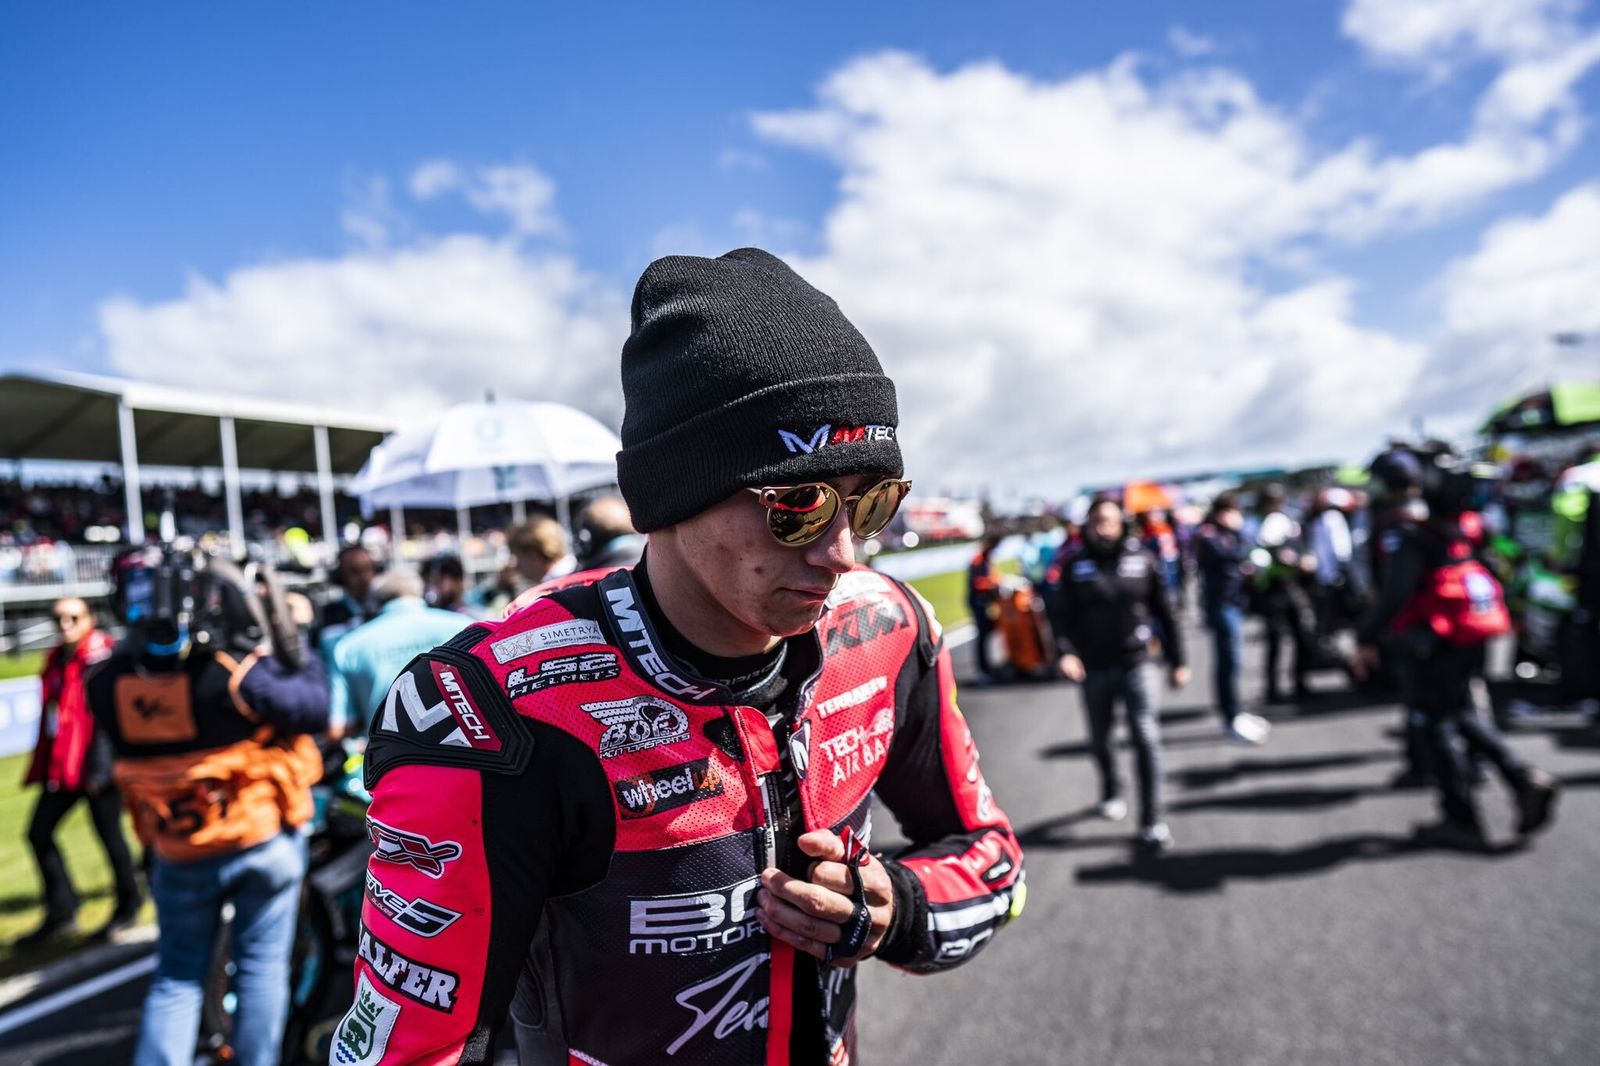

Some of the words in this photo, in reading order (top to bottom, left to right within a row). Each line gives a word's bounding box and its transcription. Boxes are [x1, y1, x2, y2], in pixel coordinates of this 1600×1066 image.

[507, 653, 617, 689] LS2
[605, 586, 718, 701] MTECH
[439, 671, 491, 740] MTECH
[509, 667, 620, 699] HELMETS
[358, 917, 456, 1009] ALFER
